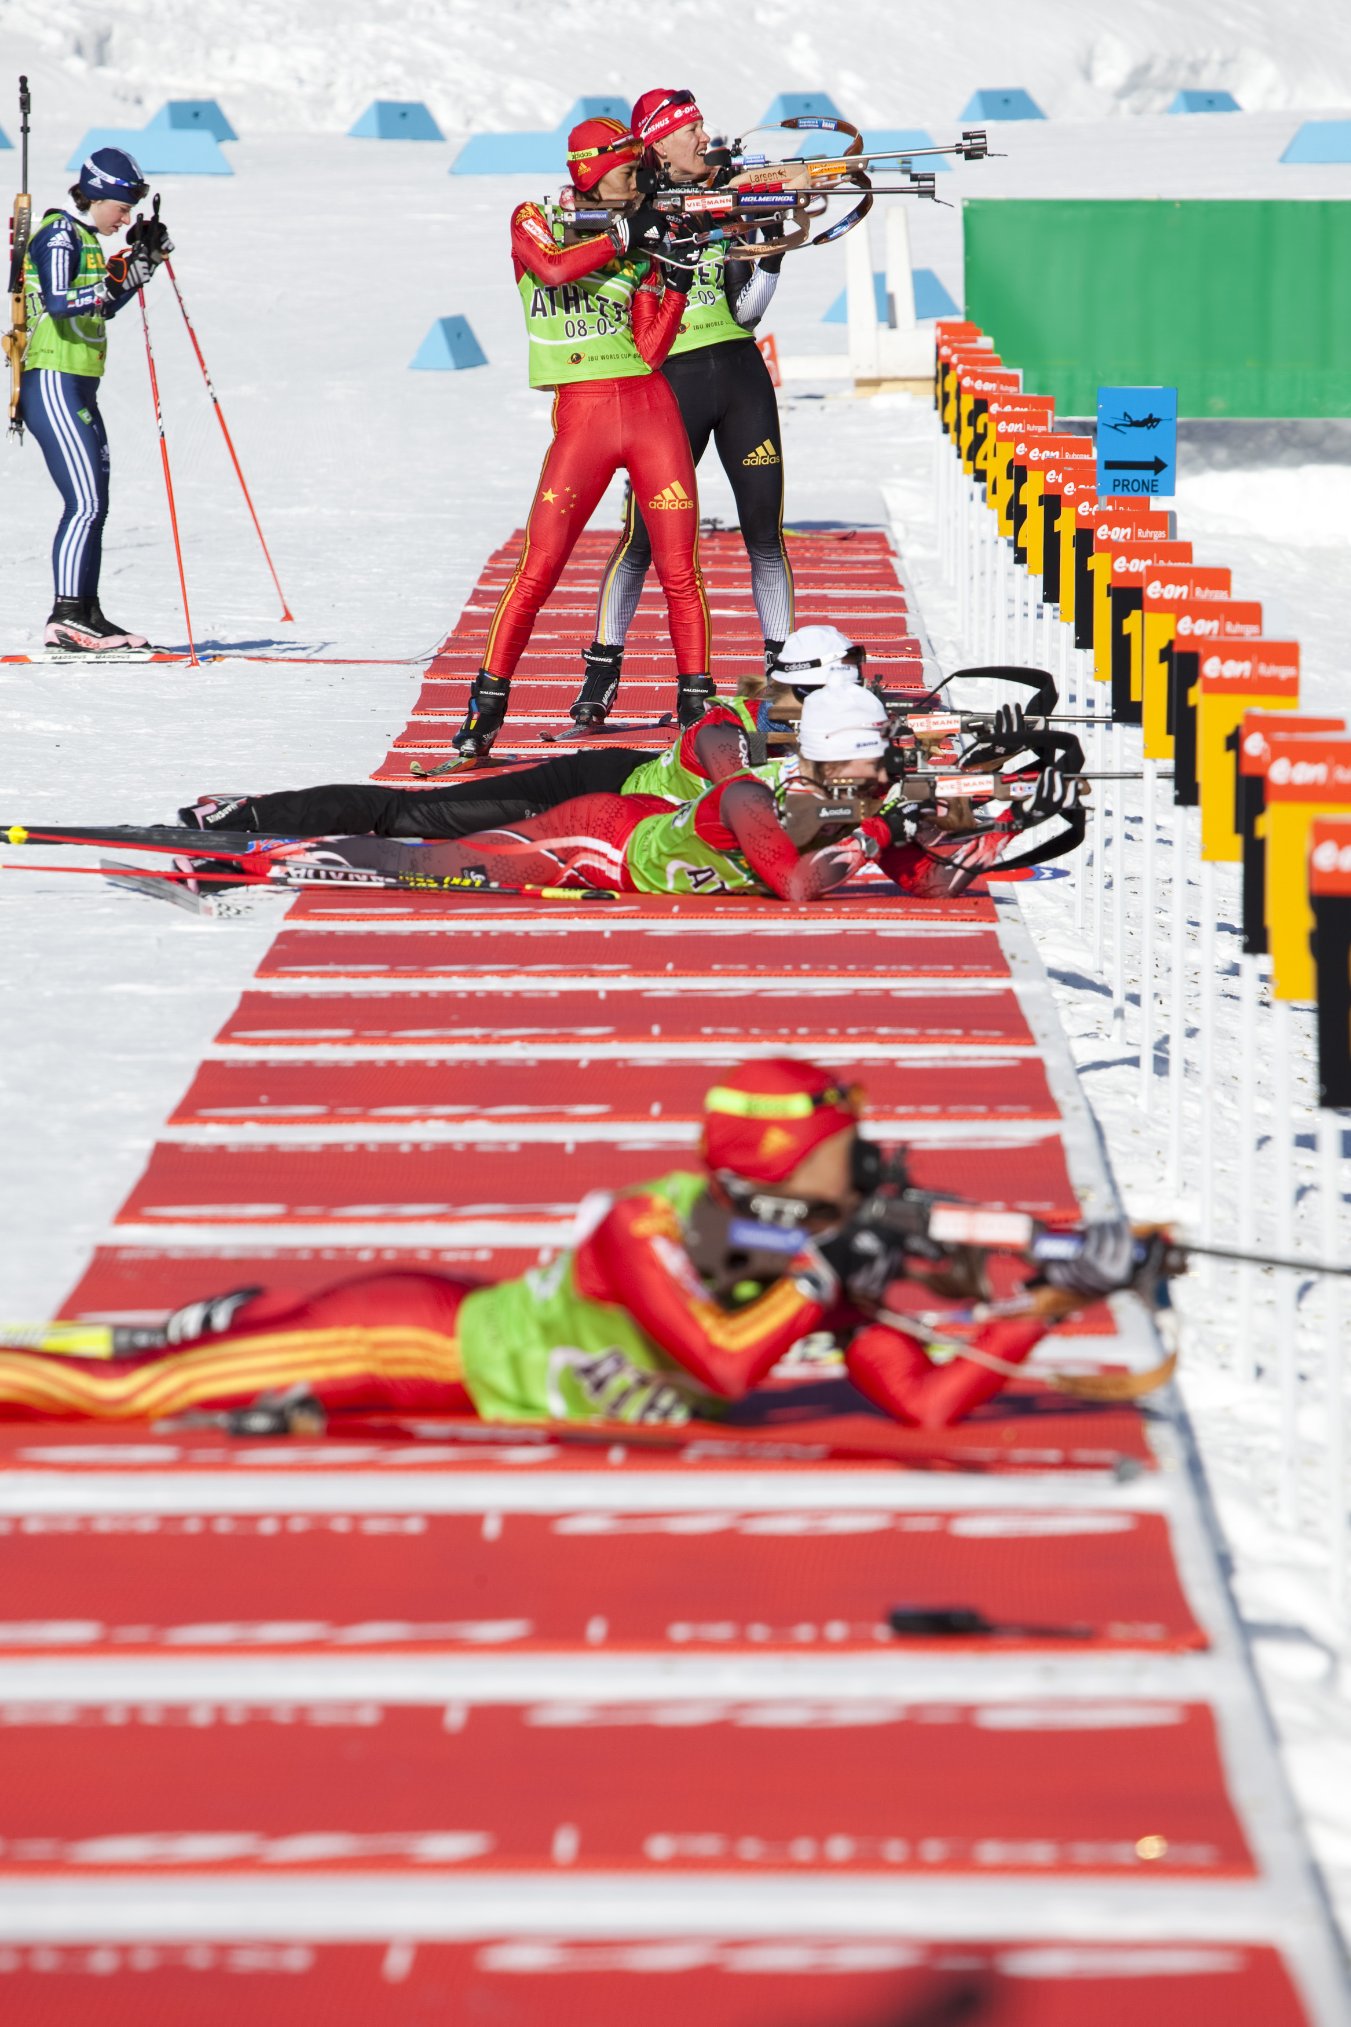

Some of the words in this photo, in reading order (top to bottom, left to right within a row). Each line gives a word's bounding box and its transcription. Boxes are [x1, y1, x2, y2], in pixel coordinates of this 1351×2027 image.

[749, 171, 779, 183] Larsen
[740, 194, 794, 202] HOLMENKOL
[742, 454, 780, 466] adidas
[1112, 479, 1159, 493] PRONE
[648, 500, 694, 510] adidas
[1137, 528, 1166, 540] Ruhrgas
